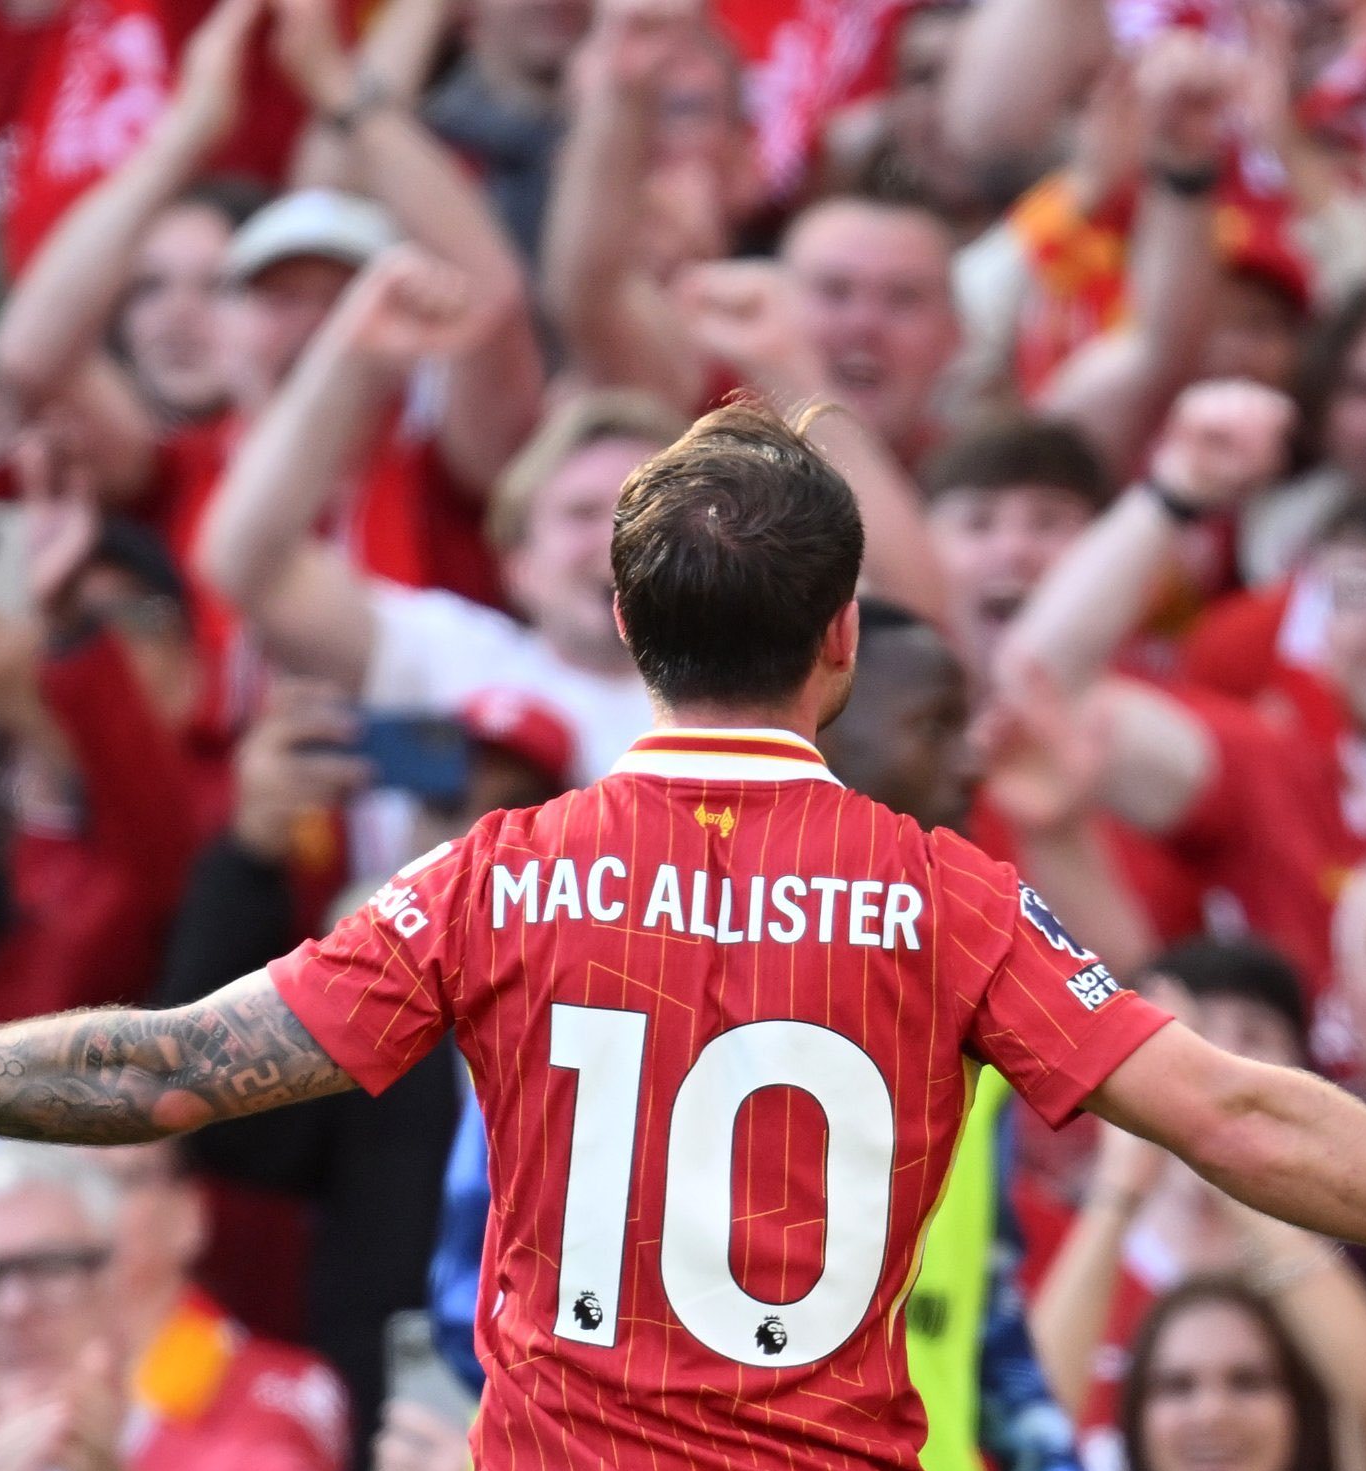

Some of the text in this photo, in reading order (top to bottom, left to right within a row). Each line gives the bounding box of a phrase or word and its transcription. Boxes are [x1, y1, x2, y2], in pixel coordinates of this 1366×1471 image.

[706, 813, 722, 825] 97
[492, 856, 924, 951] MAC ALLISTER
[549, 1003, 897, 1368] 10
